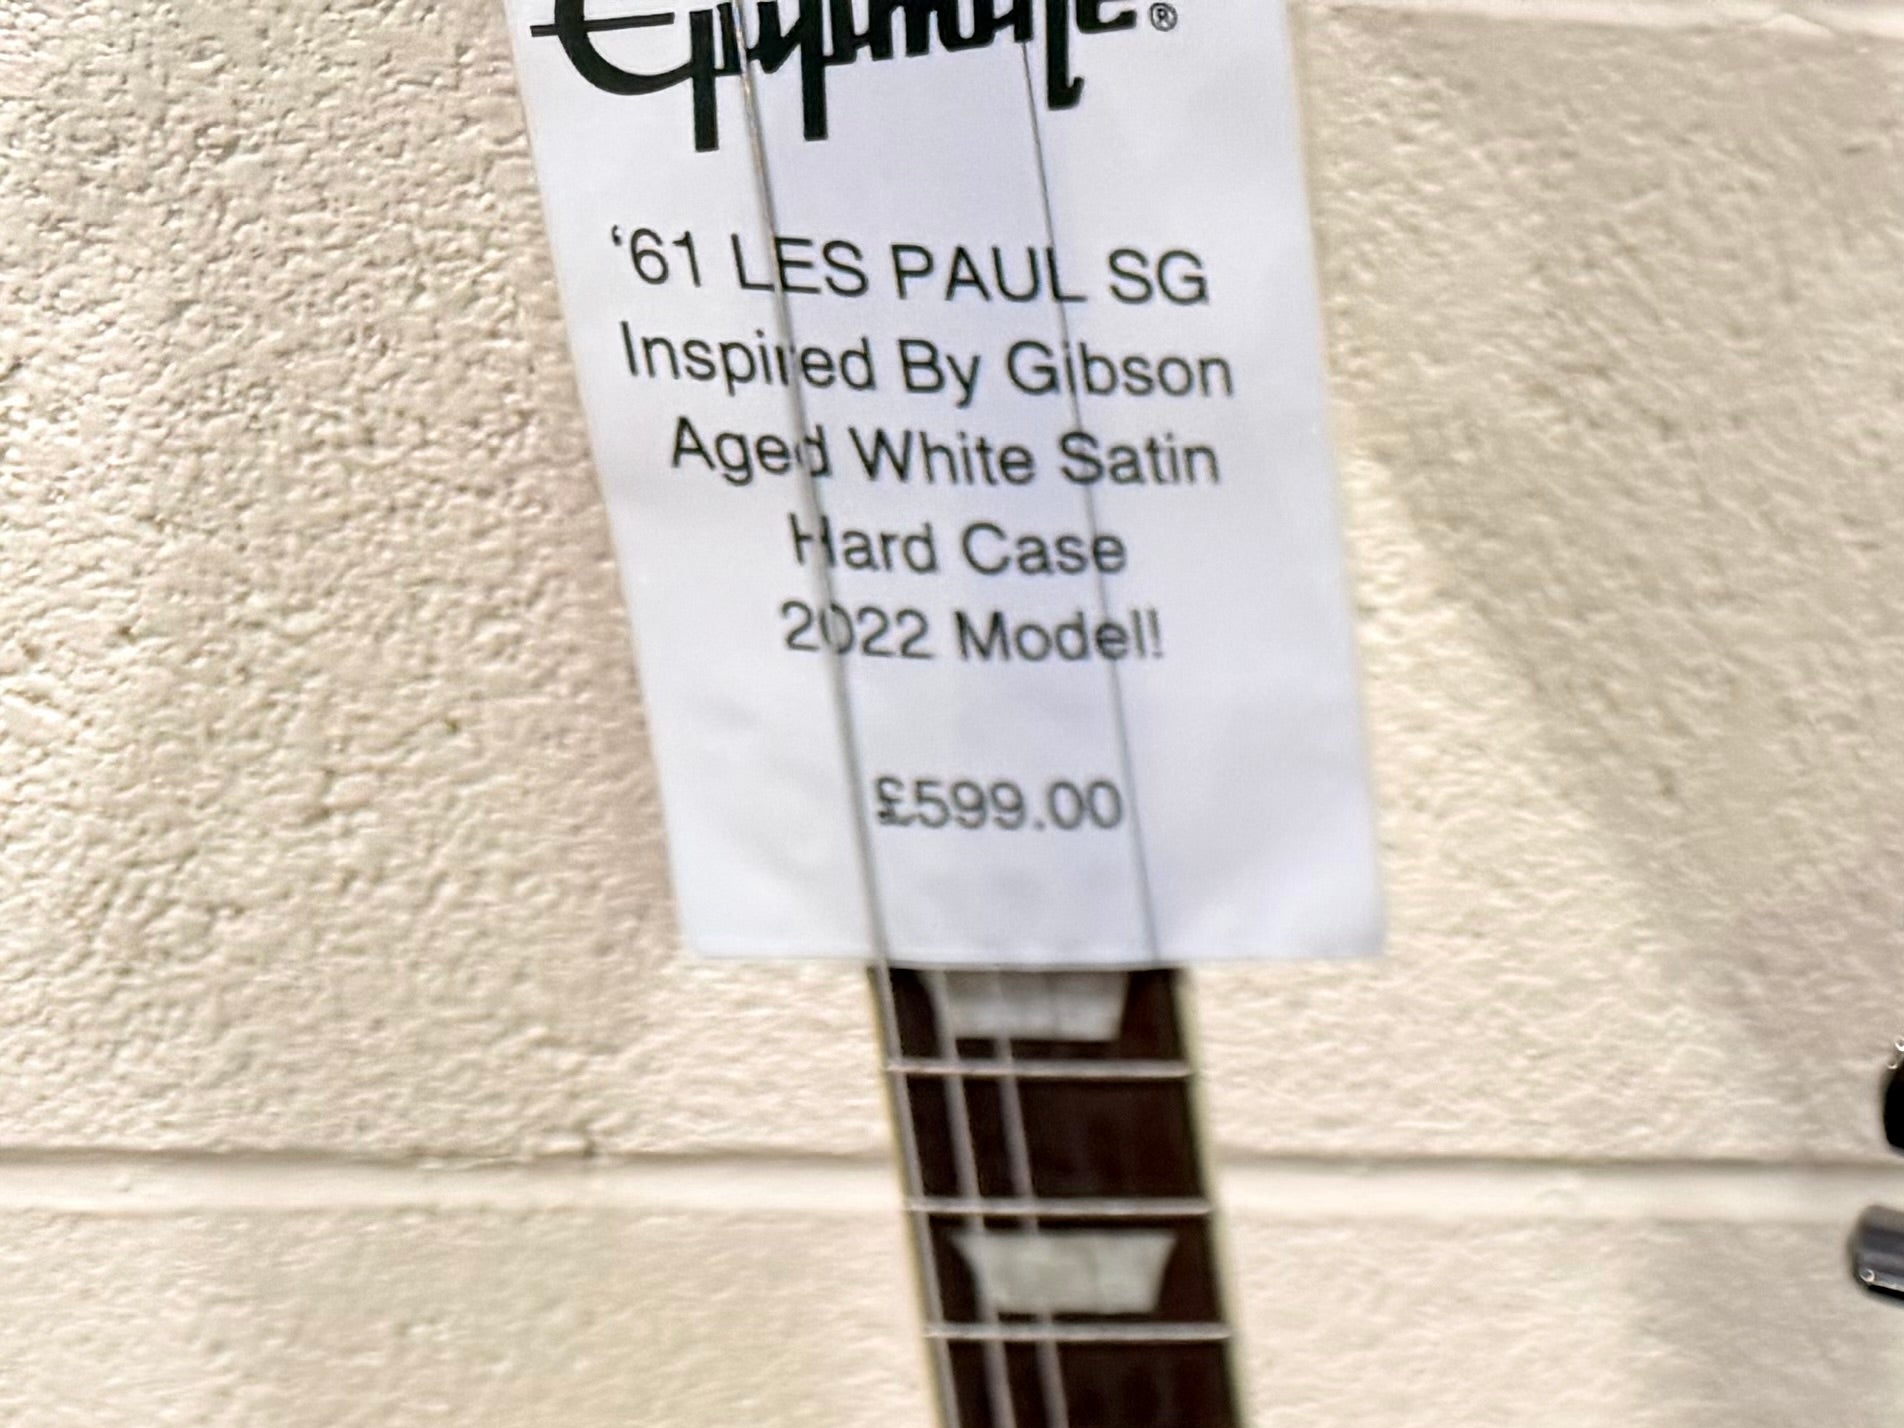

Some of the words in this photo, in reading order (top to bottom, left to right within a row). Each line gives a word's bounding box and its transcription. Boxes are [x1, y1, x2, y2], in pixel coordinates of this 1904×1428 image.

[731, 234, 867, 299] LES
[893, 242, 1087, 305] PAUL
[1108, 248, 1210, 307] SG
[620, 321, 876, 396] Inspired
[900, 338, 982, 408] By
[1006, 338, 1234, 400] Gibson
[671, 417, 830, 487] Aged
[850, 424, 1036, 484] White
[1059, 431, 1222, 487] Satin
[790, 513, 939, 576] Hard
[961, 522, 1128, 578] Case
[780, 600, 931, 661] 2022
[954, 607, 1164, 664] Model!
[874, 778, 1124, 832] £599.00
